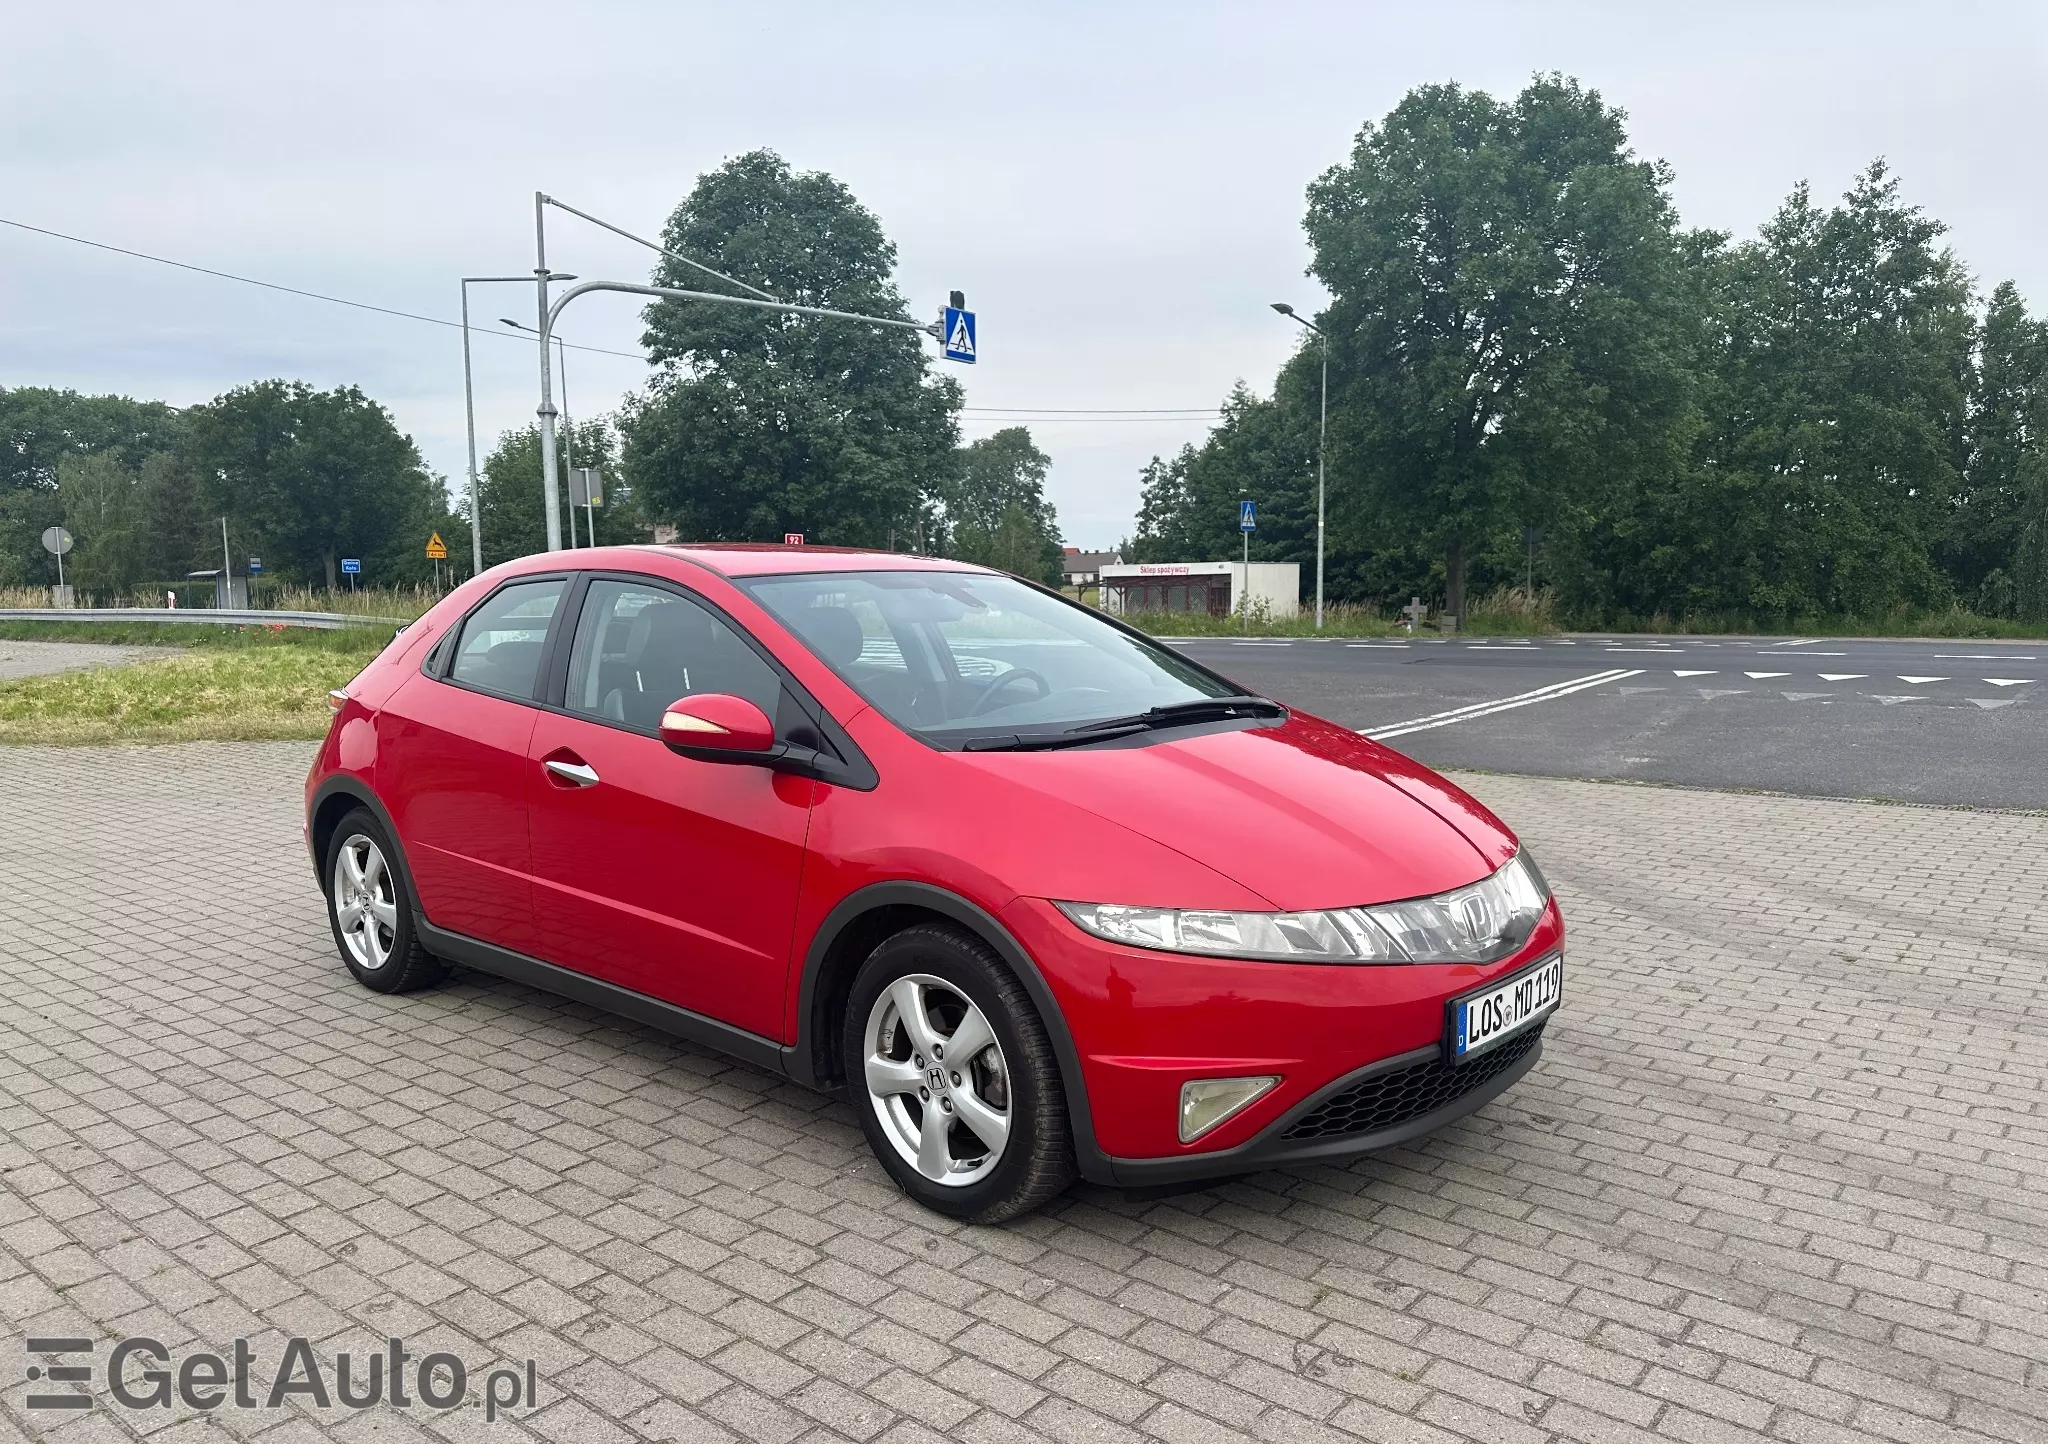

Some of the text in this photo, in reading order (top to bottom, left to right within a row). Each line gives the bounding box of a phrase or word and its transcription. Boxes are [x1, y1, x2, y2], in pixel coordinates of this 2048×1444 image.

[789, 535, 799, 544] 92
[1140, 565, 1190, 575] Sklep spożywczy
[1469, 963, 1559, 1044] LOS MD 119
[1458, 1035, 1464, 1047] D
